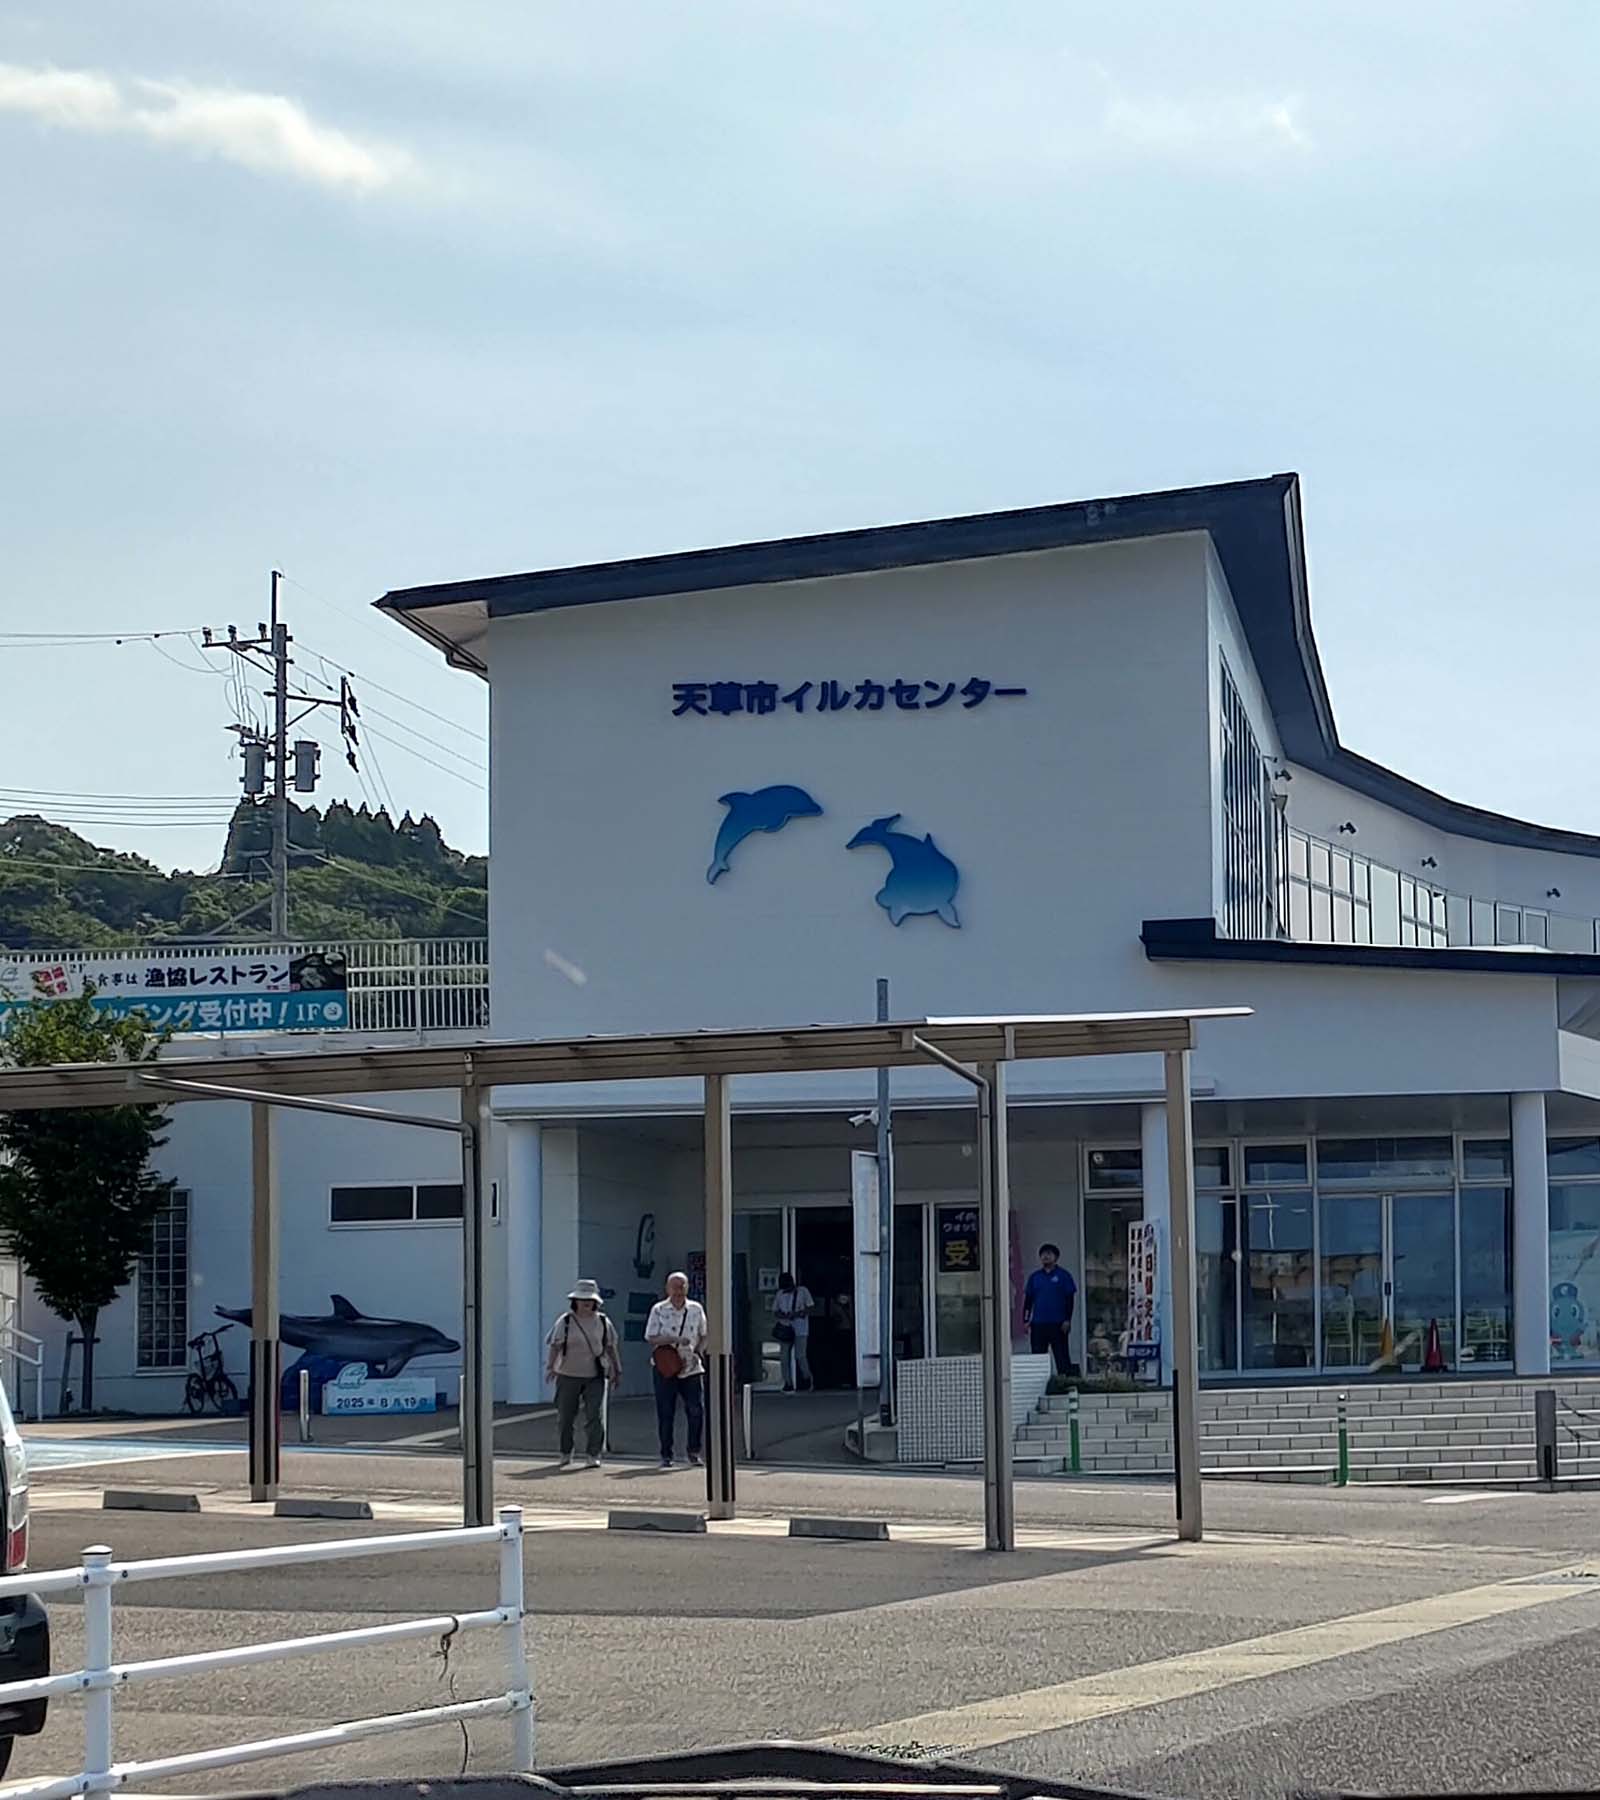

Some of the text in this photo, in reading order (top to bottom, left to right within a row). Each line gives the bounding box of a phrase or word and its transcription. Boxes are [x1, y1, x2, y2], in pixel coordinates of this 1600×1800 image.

[672, 677, 1028, 717] 天草市イルカセンター
[144, 964, 289, 988] 漁協レストラン
[296, 1002, 321, 1022] 1F
